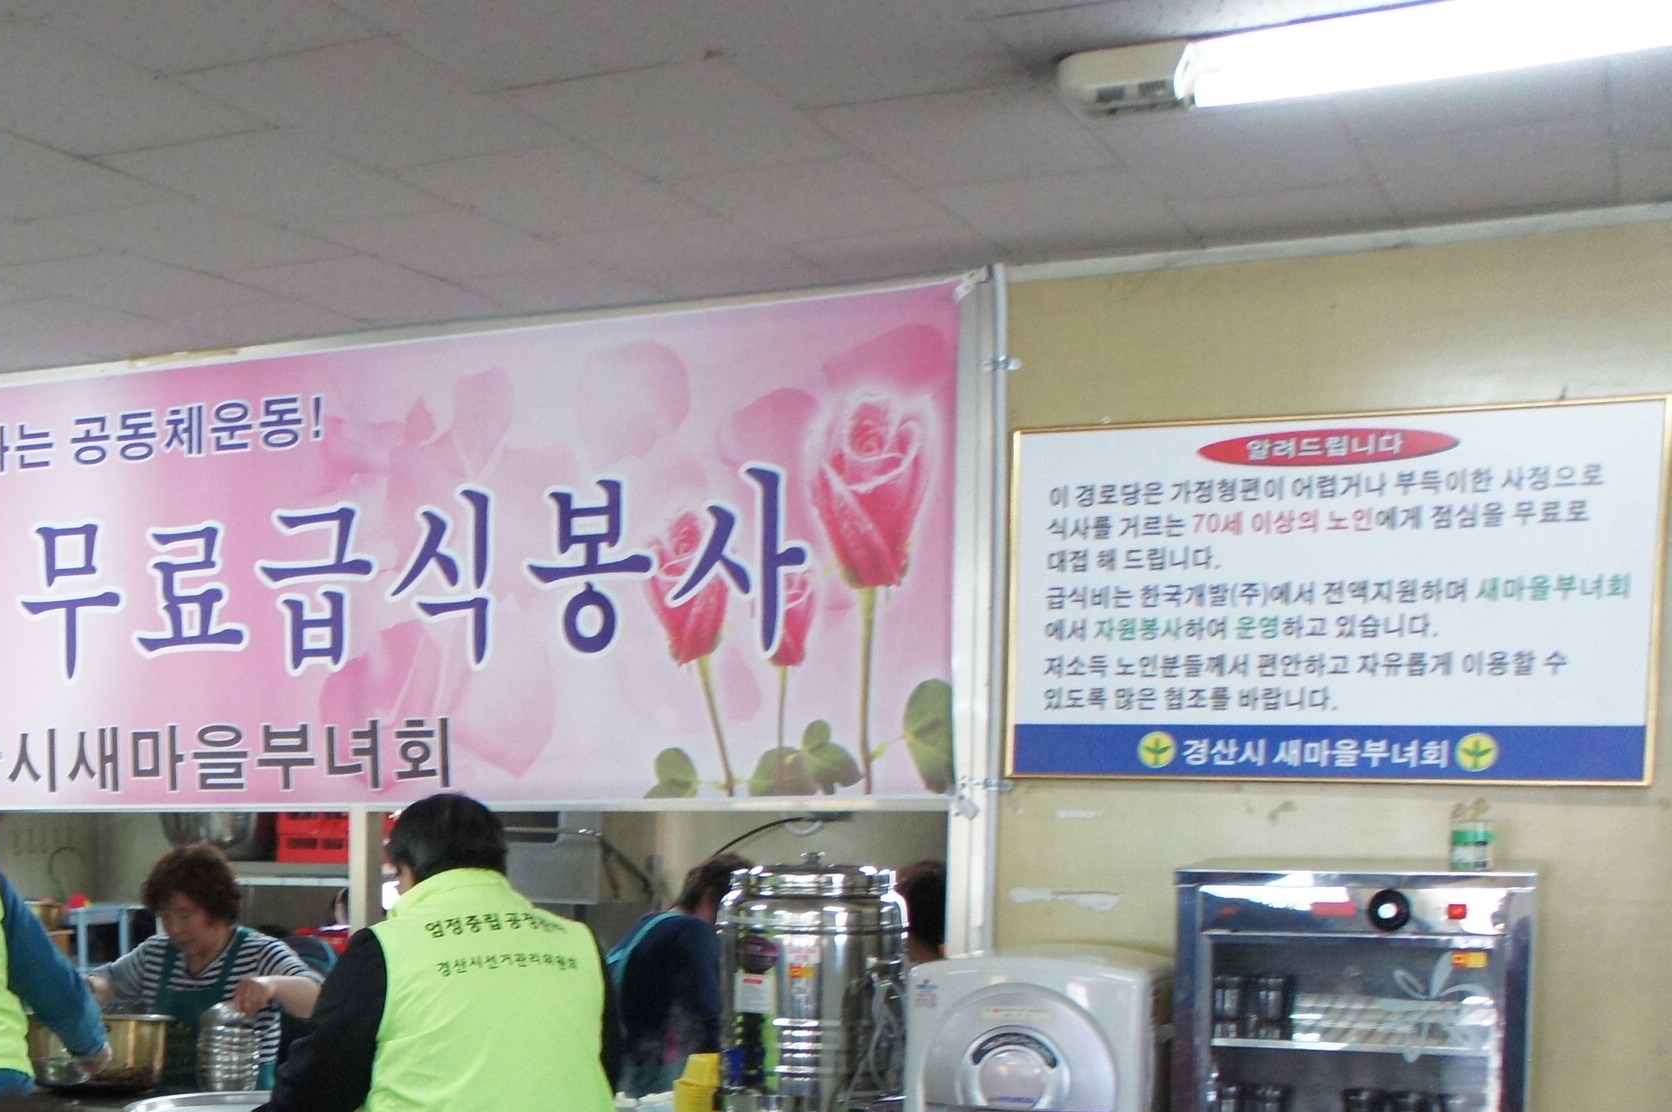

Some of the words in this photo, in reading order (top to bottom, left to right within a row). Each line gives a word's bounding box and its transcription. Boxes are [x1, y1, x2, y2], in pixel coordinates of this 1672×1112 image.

[70, 396, 325, 464] 공동체운동!
[1246, 432, 1404, 460] 알려드립니다
[1049, 485, 1069, 508] 이
[1075, 481, 1164, 508] 경로당은
[1170, 476, 1284, 504] 가정형편이
[1291, 472, 1387, 500] 어렵거나
[1393, 467, 1494, 497] 부득이한
[1500, 463, 1605, 492] 사정으로
[1047, 515, 1112, 540] 식사를
[1119, 515, 1186, 539] 거르는
[1192, 511, 1243, 535] 70세
[1251, 509, 1319, 535] 이상의
[1326, 505, 1423, 532] 노인에게
[1430, 501, 1505, 530] 점심을
[1512, 499, 1590, 526] 무료로
[1047, 549, 1088, 573] 대접
[1096, 549, 1117, 571] 해
[1123, 546, 1221, 573] 드립니다.
[1046, 585, 1133, 610] 급식비는
[1322, 577, 1468, 605] 전액지원하며
[1478, 573, 1632, 601] 새마을부녀회
[1044, 618, 1088, 642] 에서
[1094, 616, 1228, 641] 자원봉사하여
[1235, 614, 1327, 640] 운영하고
[1335, 613, 1439, 639] 있습니다.
[1043, 655, 1109, 679] 저소득
[1115, 654, 1250, 679] 노인분들께서
[1256, 653, 1349, 677] 편안하고
[1357, 651, 1453, 677] 자유롭게
[1462, 650, 1536, 677] 이용할
[1543, 651, 1568, 676] 수
[1043, 687, 1108, 711] 있도록
[1114, 688, 1157, 711] 많은
[1164, 687, 1230, 711] 협조를
[1238, 686, 1338, 711] 바랍니다.
[1182, 738, 1265, 767] 경산시
[1272, 738, 1450, 768] 새마을부녀회
[425, 913, 502, 939] 엄정중립
